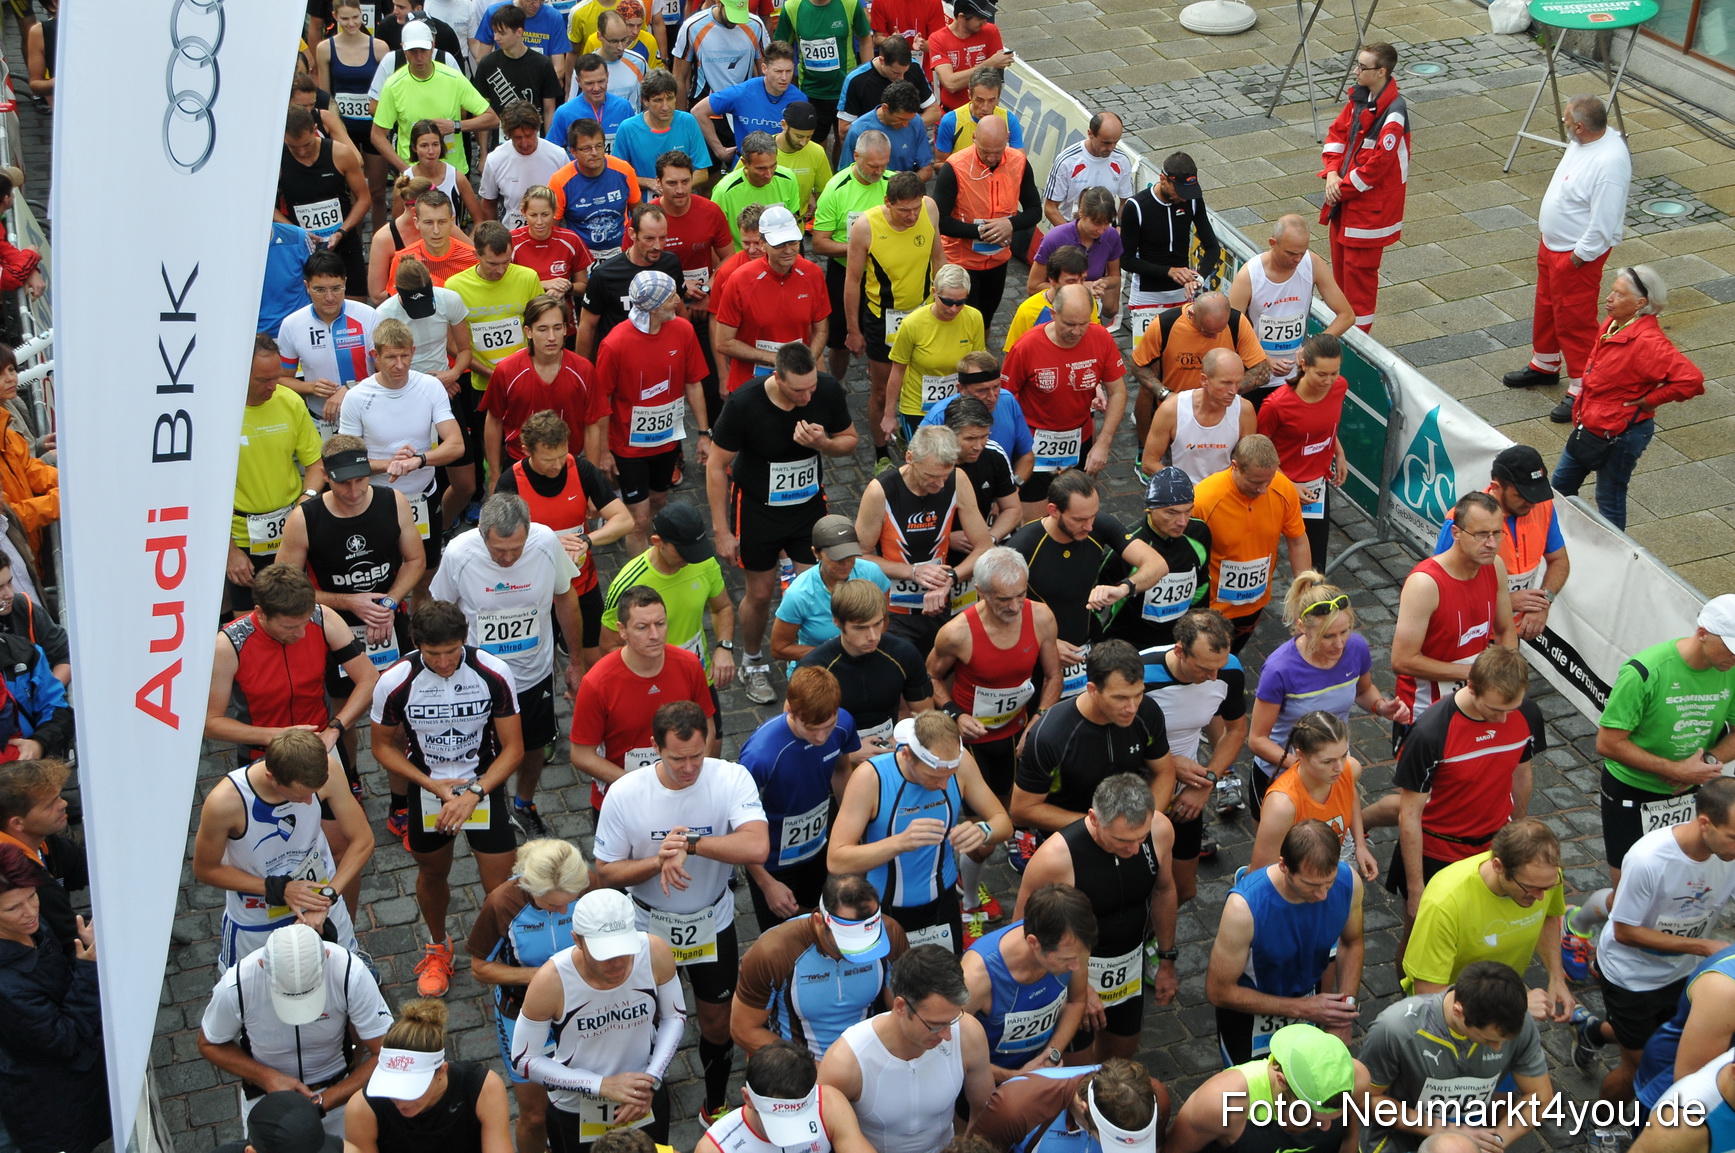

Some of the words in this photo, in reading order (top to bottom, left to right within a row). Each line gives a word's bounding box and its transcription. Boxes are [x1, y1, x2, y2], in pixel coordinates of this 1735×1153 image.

[666, 1, 678, 13] 13
[522, 32, 550, 40] MARKTER
[805, 46, 835, 60] 2409
[751, 117, 782, 128] ruhrga
[302, 209, 338, 228] 2469
[468, 304, 513, 317] CRAFT
[489, 322, 512, 331] Neumarkt
[1264, 322, 1302, 340] 2759
[483, 330, 514, 348] 632
[152, 260, 200, 464] BKK
[928, 384, 960, 400] 232
[636, 412, 673, 432] 2358
[1037, 440, 1078, 456] 2390
[790, 462, 812, 472] Neumarkt
[776, 468, 814, 490] 2169
[1396, 504, 1426, 532] Gebäude
[1426, 524, 1440, 540] Serv
[268, 541, 282, 550] Mar
[1242, 562, 1266, 570] Neumarkt
[1168, 576, 1192, 584] Neumarkt
[1224, 567, 1267, 588] 2055
[1150, 582, 1194, 604] 2439
[135, 506, 190, 731] Audi
[500, 612, 530, 620] Neumarkt
[484, 618, 534, 642] 2027
[498, 643, 522, 653] Alfred
[370, 656, 388, 664] tian
[1536, 633, 1550, 652] en,
[1551, 646, 1568, 666] die
[1569, 660, 1610, 708] verbinde
[976, 690, 998, 698] PARTL
[998, 688, 1026, 698] Neumarkt
[1666, 694, 1720, 704] SCHMINKE
[410, 700, 490, 718] POSITIV
[995, 696, 1018, 714] 15
[424, 731, 478, 746] WOLFRUM
[650, 912, 672, 924] PARTL
[674, 915, 706, 925] Neumarkt
[670, 924, 698, 946] 52
[909, 933, 940, 946] Neumarkt
[672, 948, 704, 960] olfgang
[1106, 954, 1136, 968] Neumarkt
[1100, 966, 1127, 988] 68
[594, 1000, 631, 1015] TEAM
[576, 1002, 648, 1032] ERDINGER
[1006, 1016, 1030, 1026] PARTL
[579, 1016, 649, 1040] ALKOHOLFREI
[1482, 1052, 1504, 1062] kicker
[1426, 1083, 1452, 1092] PARTL
[1454, 1083, 1490, 1092] Neumarkt
[597, 1104, 622, 1122] 1
